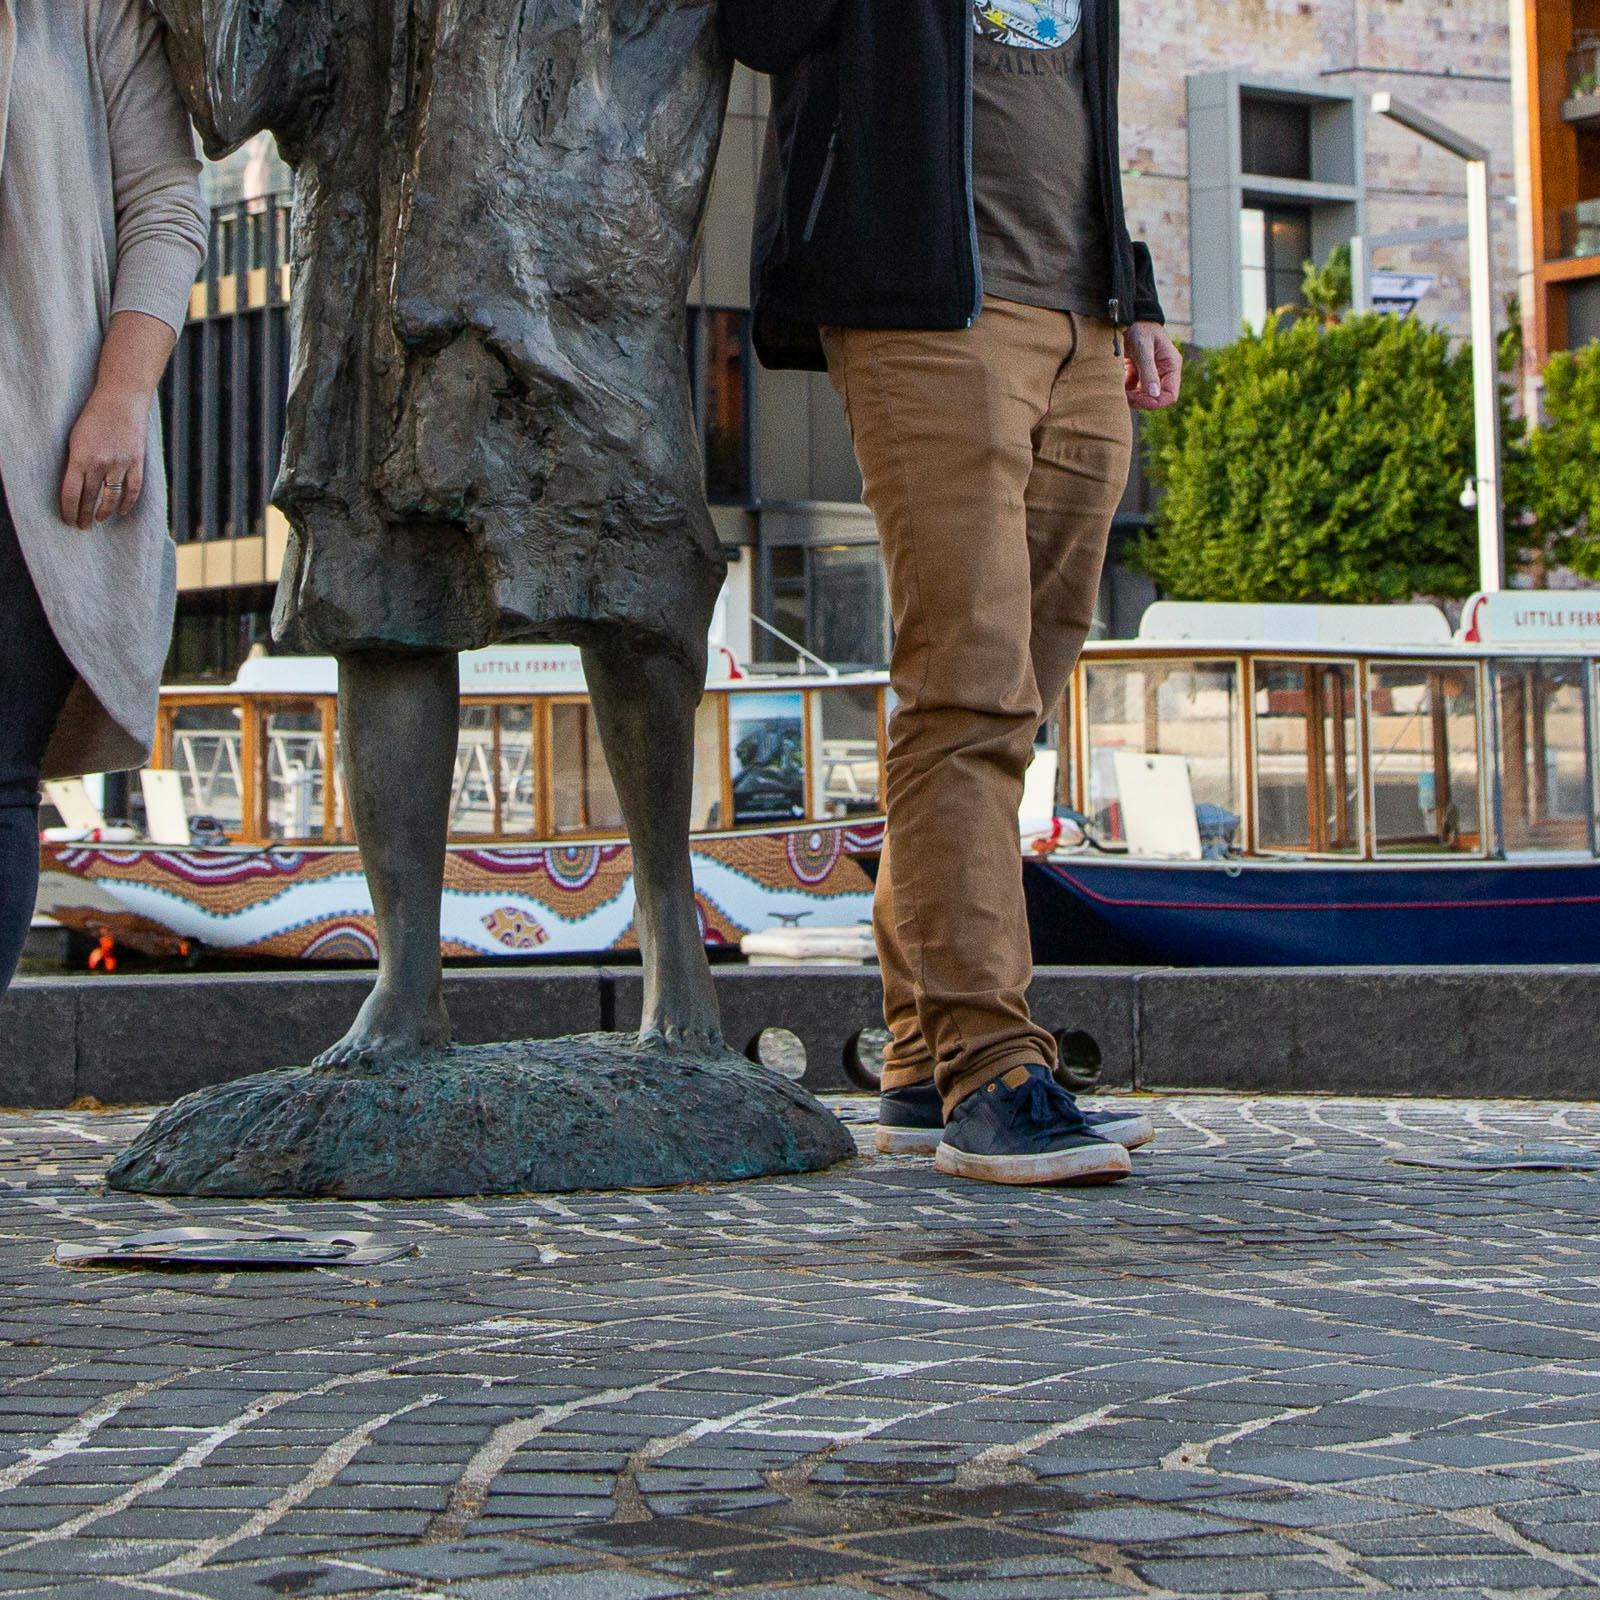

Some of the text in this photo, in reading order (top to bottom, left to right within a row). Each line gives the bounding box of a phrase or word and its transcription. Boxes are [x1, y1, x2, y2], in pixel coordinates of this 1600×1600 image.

[1514, 610, 1564, 627] LITTLE
[474, 660, 520, 674] LITTLE
[525, 659, 568, 674] FERRY
